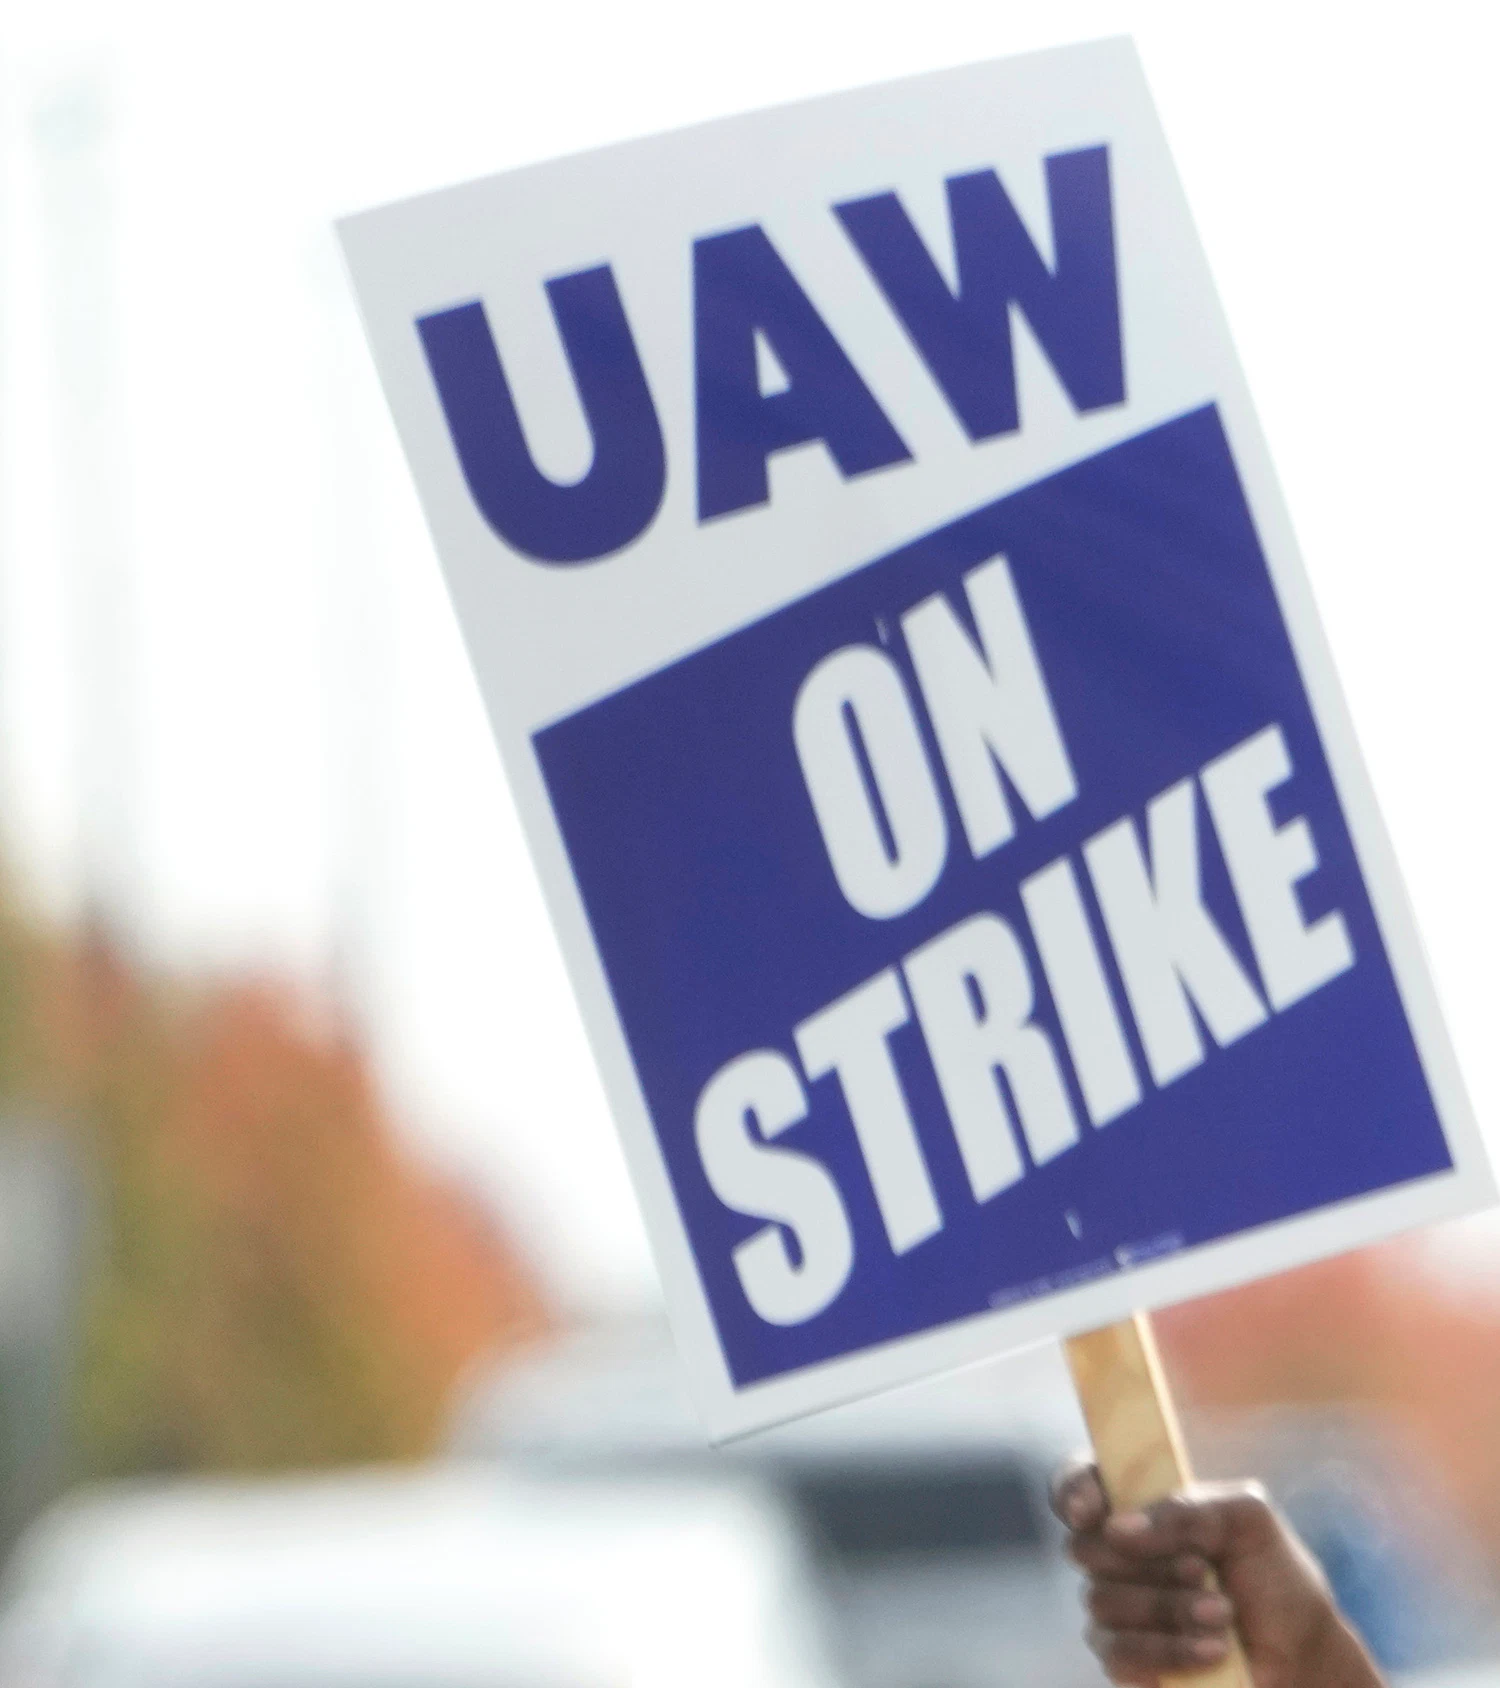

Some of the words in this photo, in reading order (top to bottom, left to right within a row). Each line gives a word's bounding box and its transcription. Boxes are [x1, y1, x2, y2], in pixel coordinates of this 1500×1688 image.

[414, 143, 1127, 571] UAW
[792, 551, 1078, 921] ON
[694, 723, 1355, 1328] STRIKE
